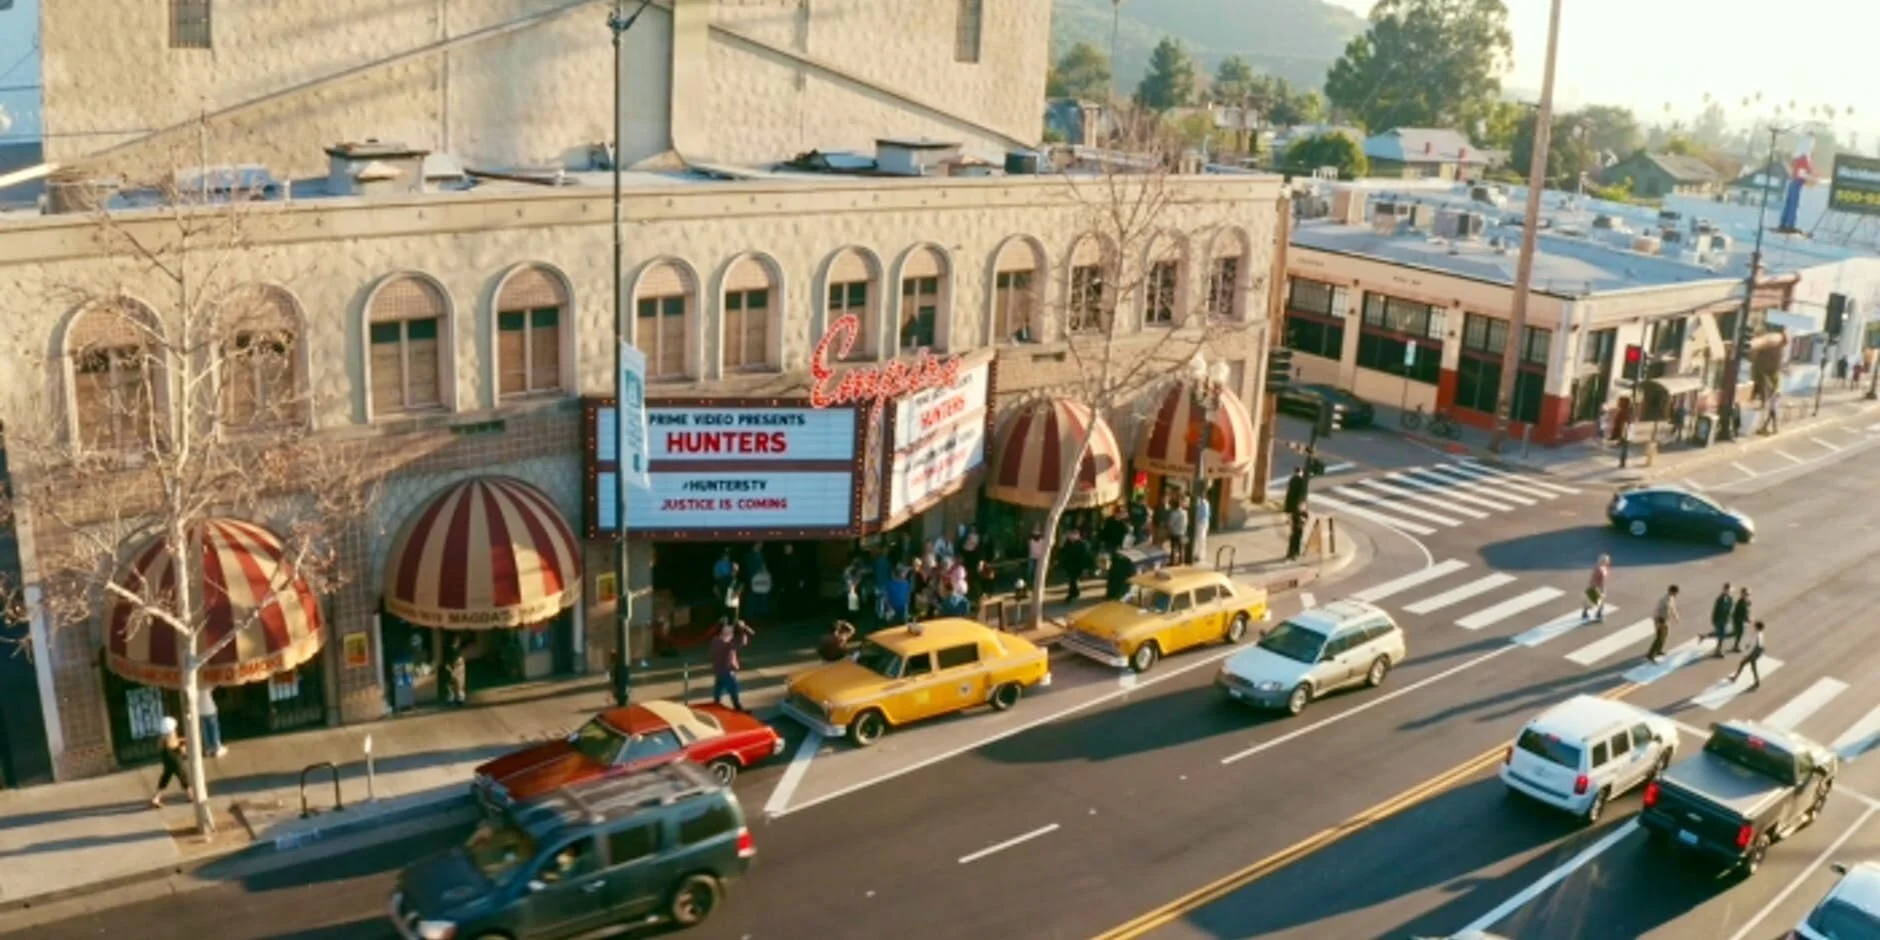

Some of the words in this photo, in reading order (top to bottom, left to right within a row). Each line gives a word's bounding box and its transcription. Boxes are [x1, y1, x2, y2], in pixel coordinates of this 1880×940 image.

[811, 313, 961, 427] Empire
[649, 413, 688, 426] PRIME
[693, 413, 733, 426] VIDEO
[738, 413, 806, 426] PRESENTS
[666, 431, 787, 454] HUNTERS
[660, 498, 714, 511] JUSTICE
[718, 498, 733, 510] IS
[737, 498, 788, 510] COMING
